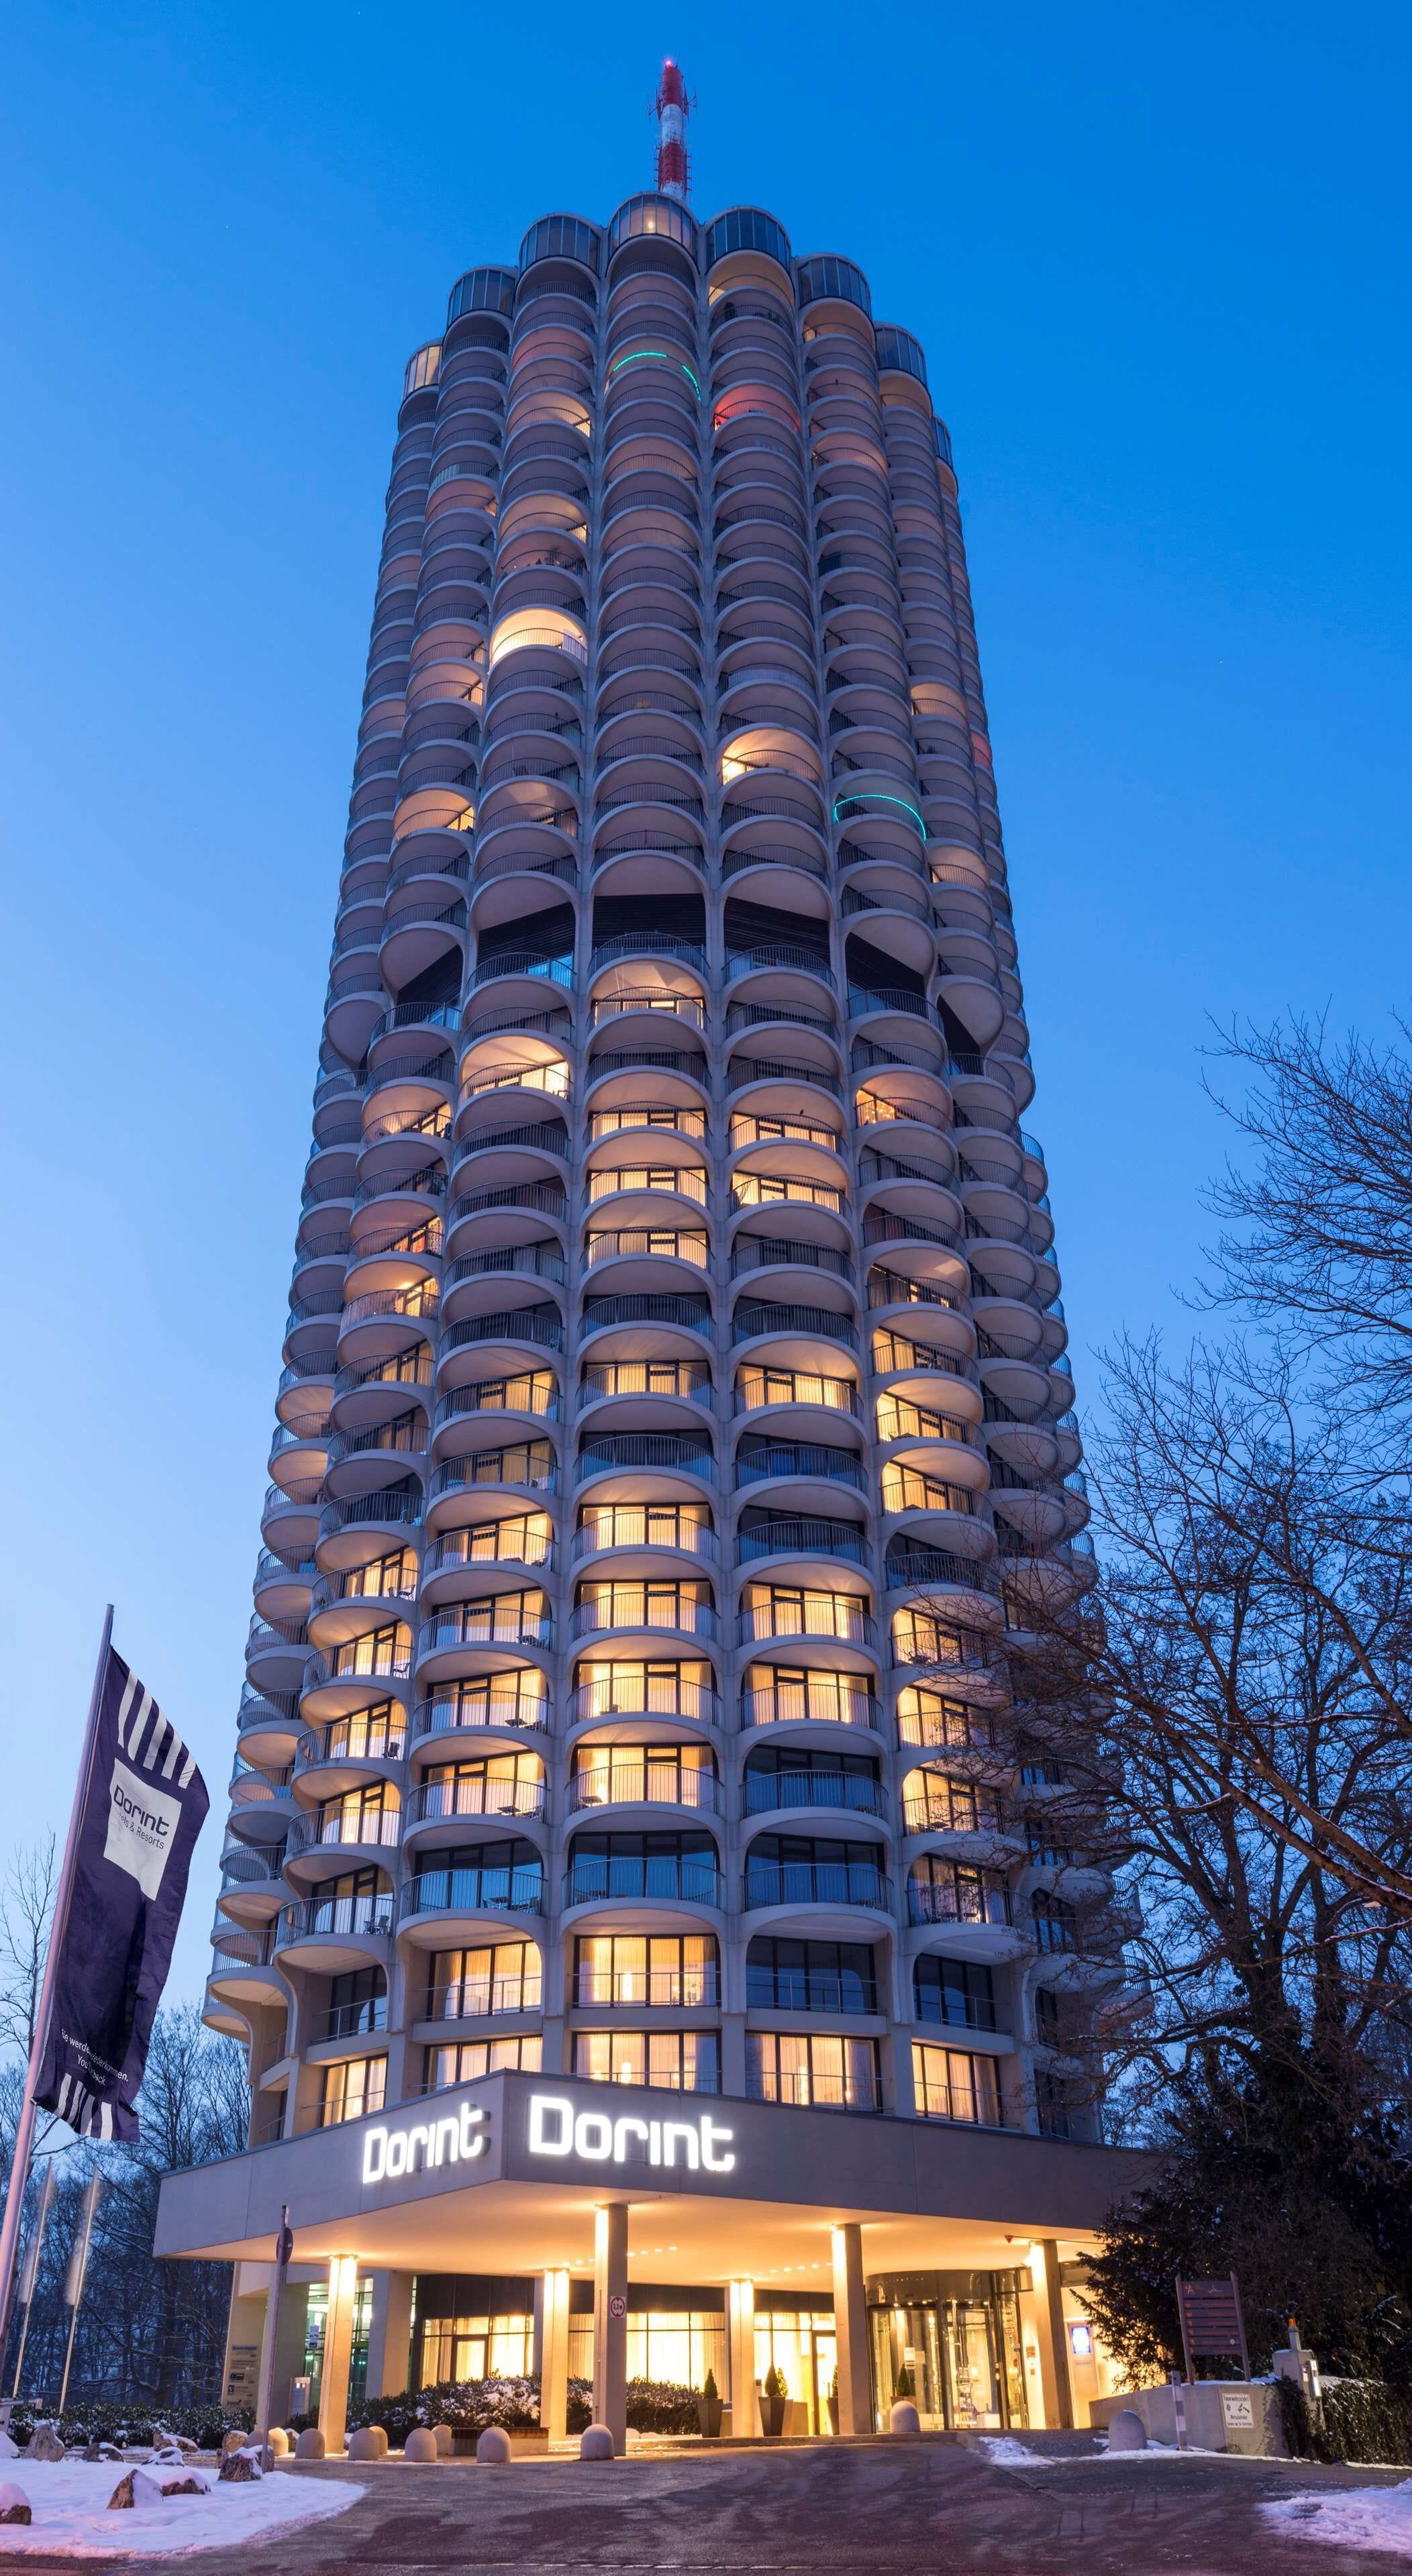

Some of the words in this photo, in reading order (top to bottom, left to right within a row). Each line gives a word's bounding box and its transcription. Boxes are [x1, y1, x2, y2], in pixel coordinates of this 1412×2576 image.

[113, 1785, 170, 1837] Dorint
[130, 1822, 135, 1832] &
[136, 1826, 165, 1849] Resorts
[69, 2037, 91, 2054] werde
[362, 2102, 483, 2183] Dorint
[530, 2095, 735, 2171] Dorint
